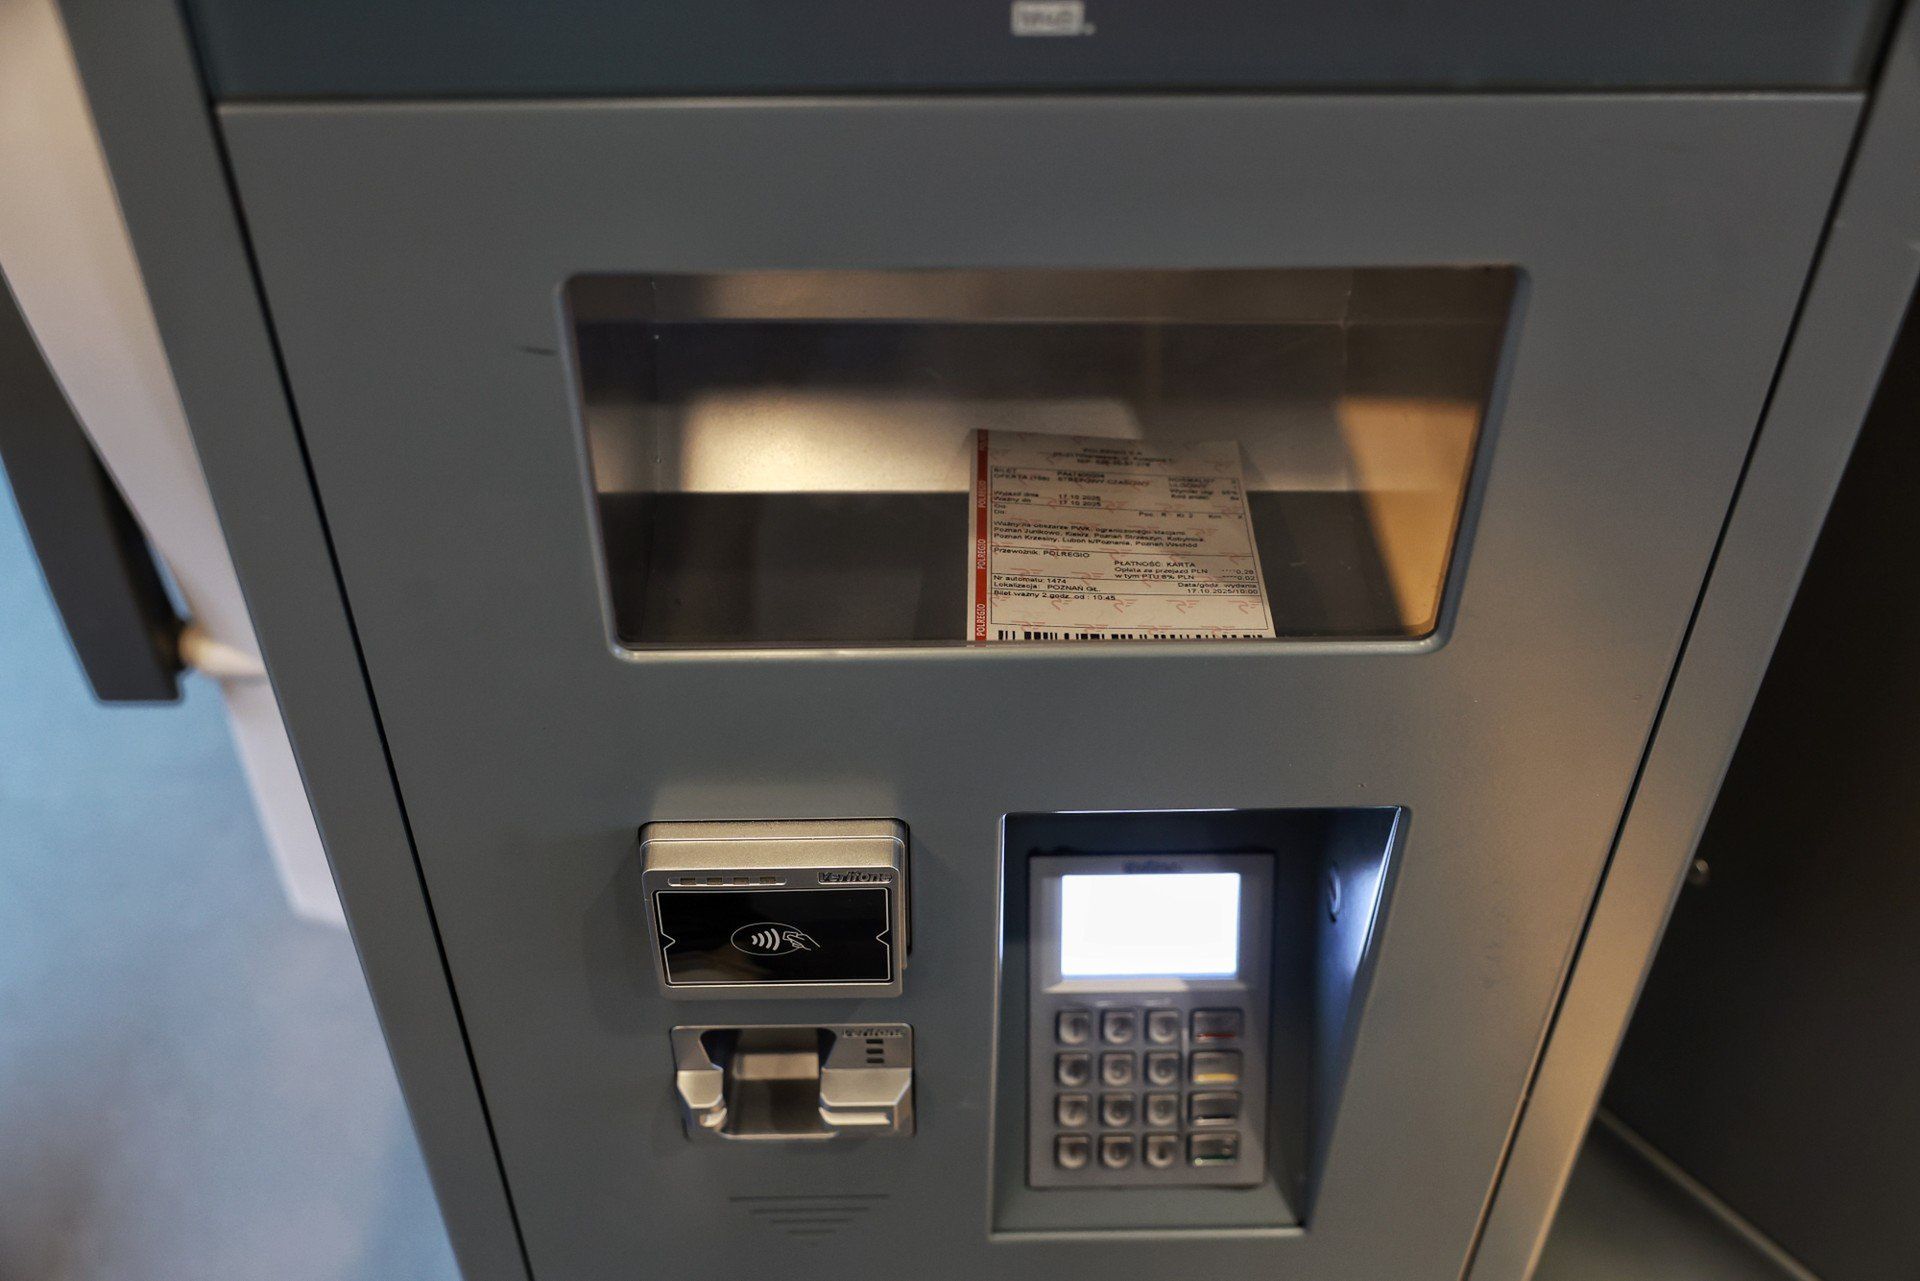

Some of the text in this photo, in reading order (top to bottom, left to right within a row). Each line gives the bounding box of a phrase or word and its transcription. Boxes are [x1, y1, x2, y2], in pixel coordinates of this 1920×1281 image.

[977, 539, 986, 570] POLREGIO
[1043, 550, 1090, 558] POLREGIO
[976, 603, 986, 637] POLREGIO
